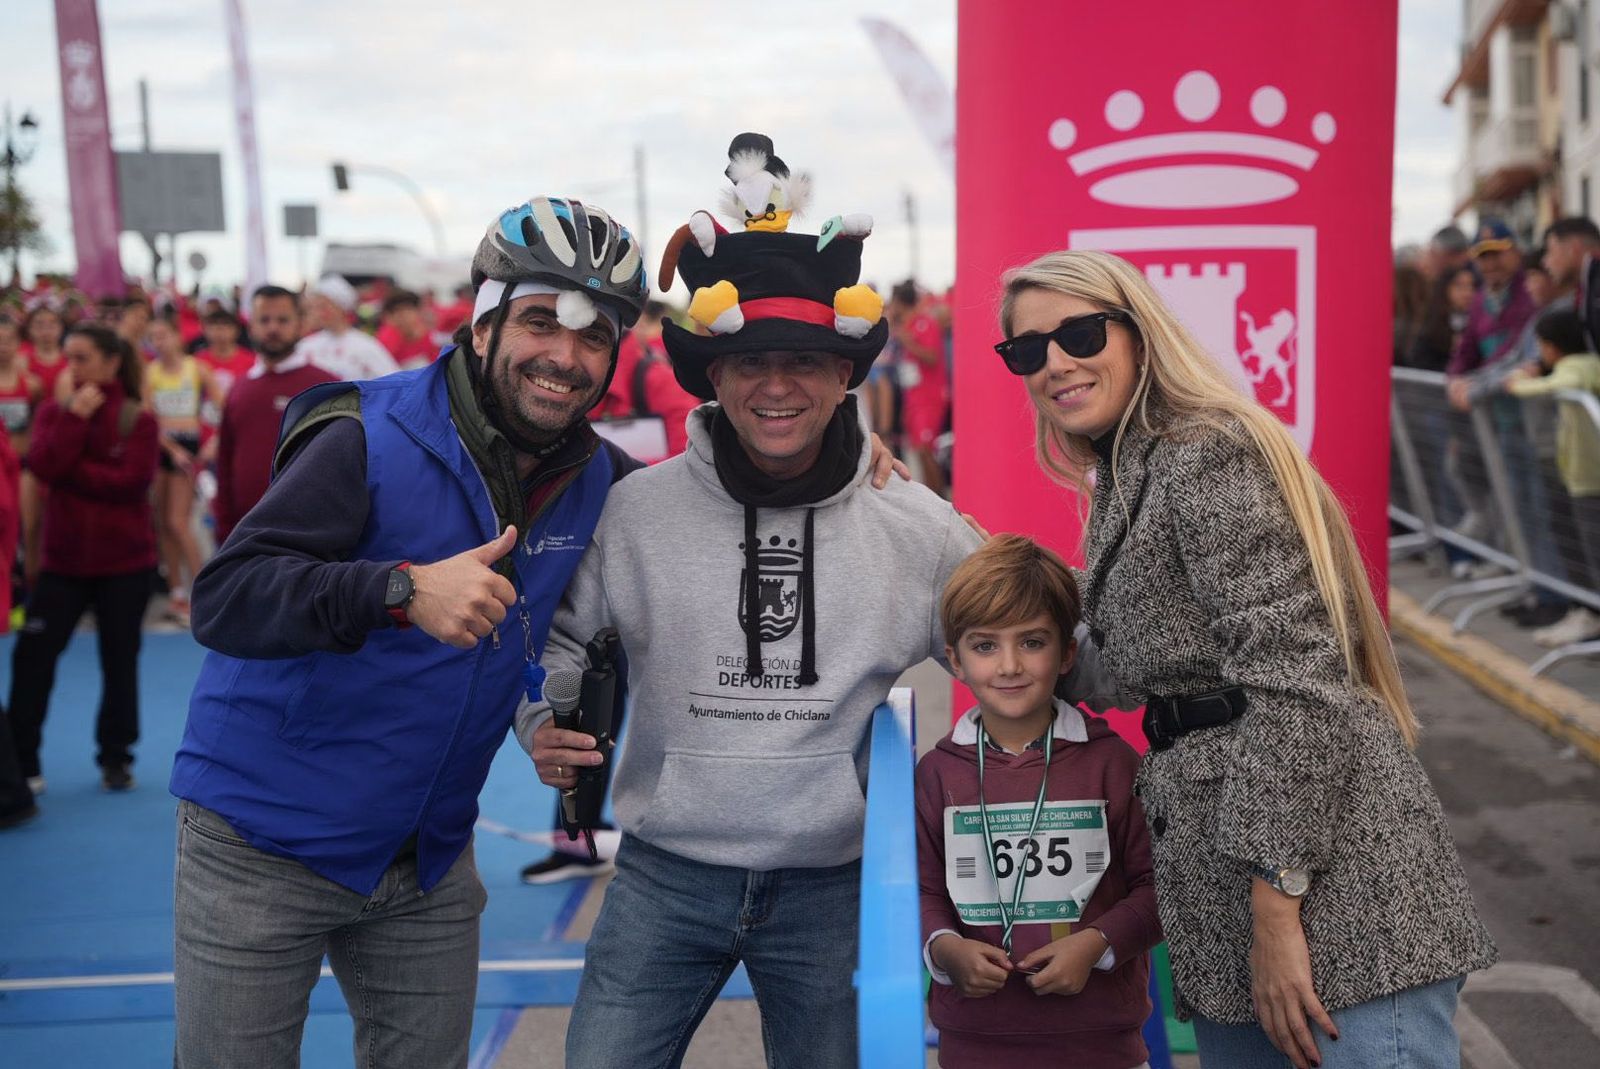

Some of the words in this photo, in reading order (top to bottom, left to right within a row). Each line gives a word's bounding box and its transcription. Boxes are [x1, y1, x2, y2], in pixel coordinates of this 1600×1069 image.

[717, 655, 790, 670] DELECIÓN
[793, 659, 802, 671] D
[719, 672, 802, 690] DEPORTES
[688, 704, 765, 721] Ayuntamiento
[766, 710, 781, 721] de
[784, 710, 831, 721] Chiclana
[963, 814, 996, 825] CARRRA
[996, 813, 1010, 823] SAN
[1011, 812, 1049, 823] SILVESRE
[1049, 810, 1093, 821] CHICLANERA
[993, 837, 1073, 879] 635
[968, 907, 1001, 917] DICIEMBR
